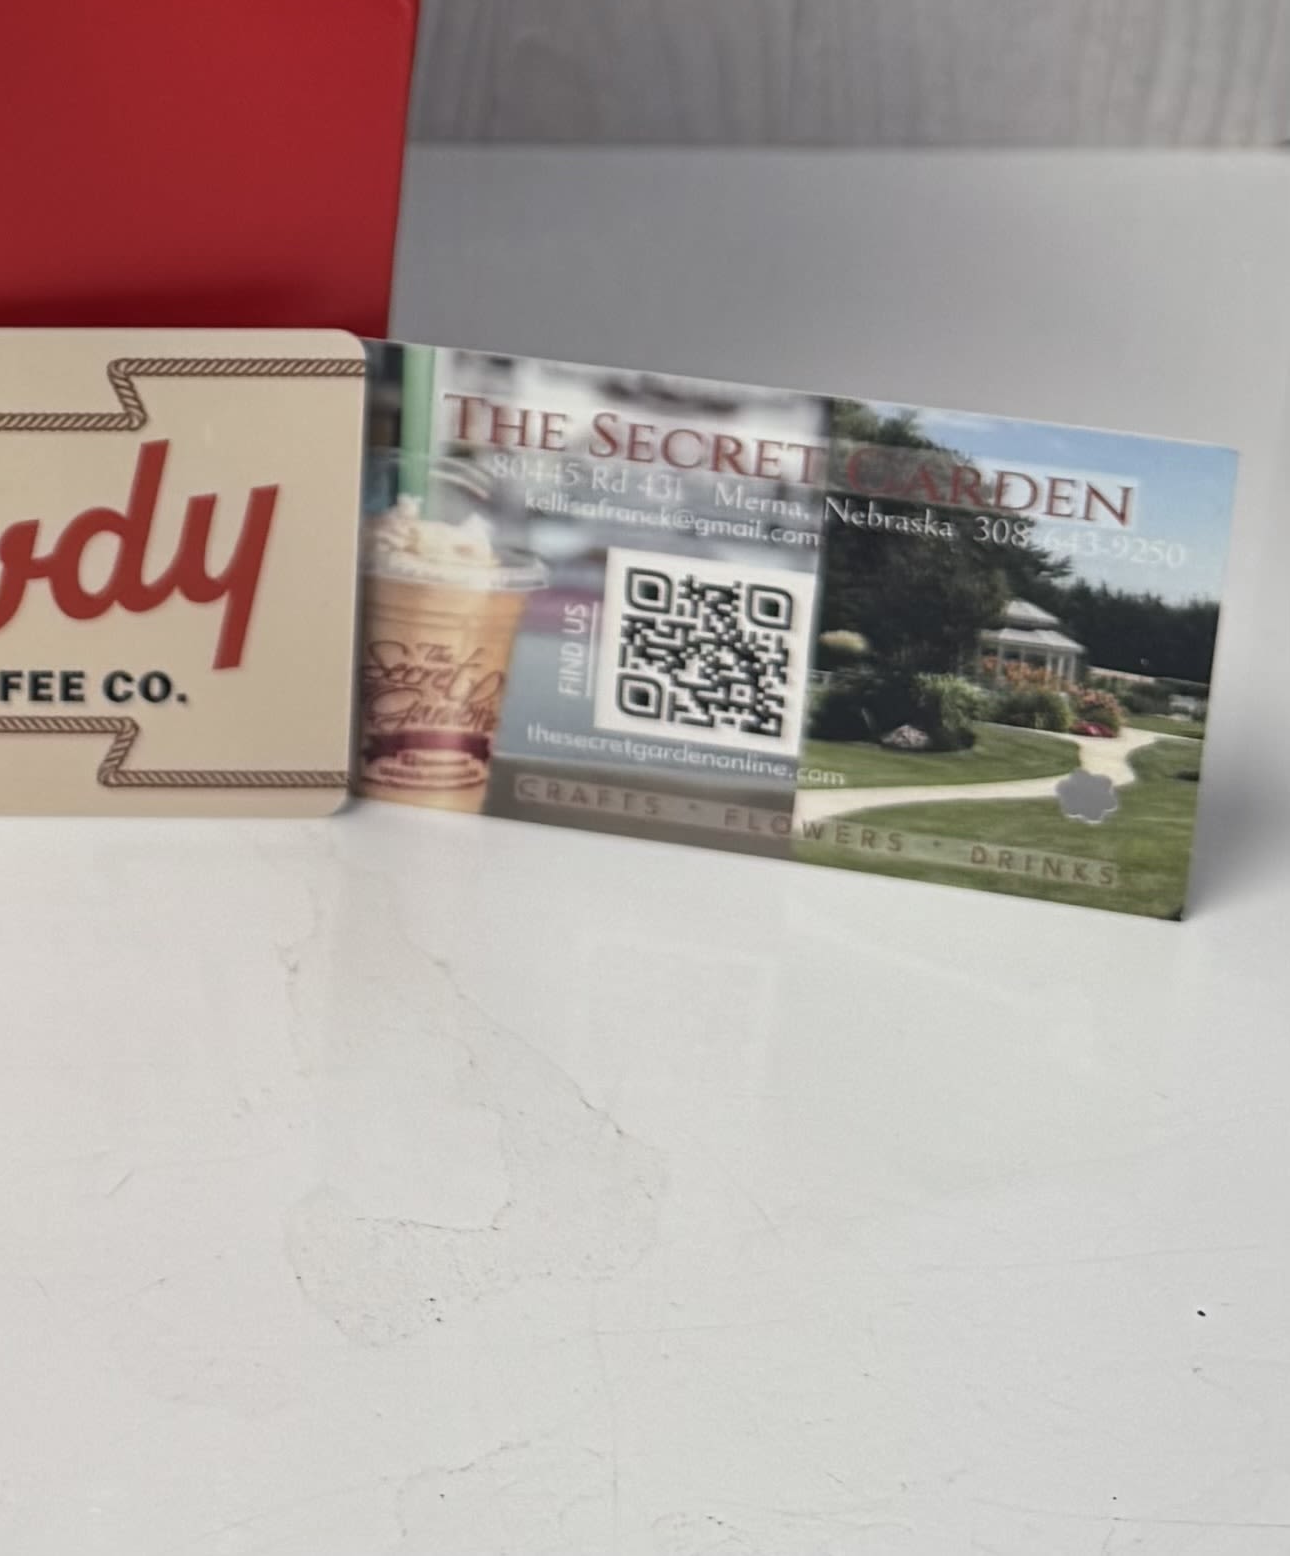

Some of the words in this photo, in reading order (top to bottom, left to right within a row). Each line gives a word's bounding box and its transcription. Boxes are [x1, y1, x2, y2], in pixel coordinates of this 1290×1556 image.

[444, 392, 567, 452] THE
[588, 412, 828, 486] SECRET
[847, 447, 1135, 527] GARDEN
[591, 465, 627, 495] Rd
[824, 496, 954, 539] Nebraska
[562, 602, 589, 634] US
[102, 670, 190, 705] CO.
[559, 641, 585, 696] FIND
[527, 722, 846, 788] thesecretgardenonline.com
[518, 777, 659, 816] CRAFTS
[723, 807, 905, 852] FLOWERS
[969, 845, 1115, 886] DRINKS
